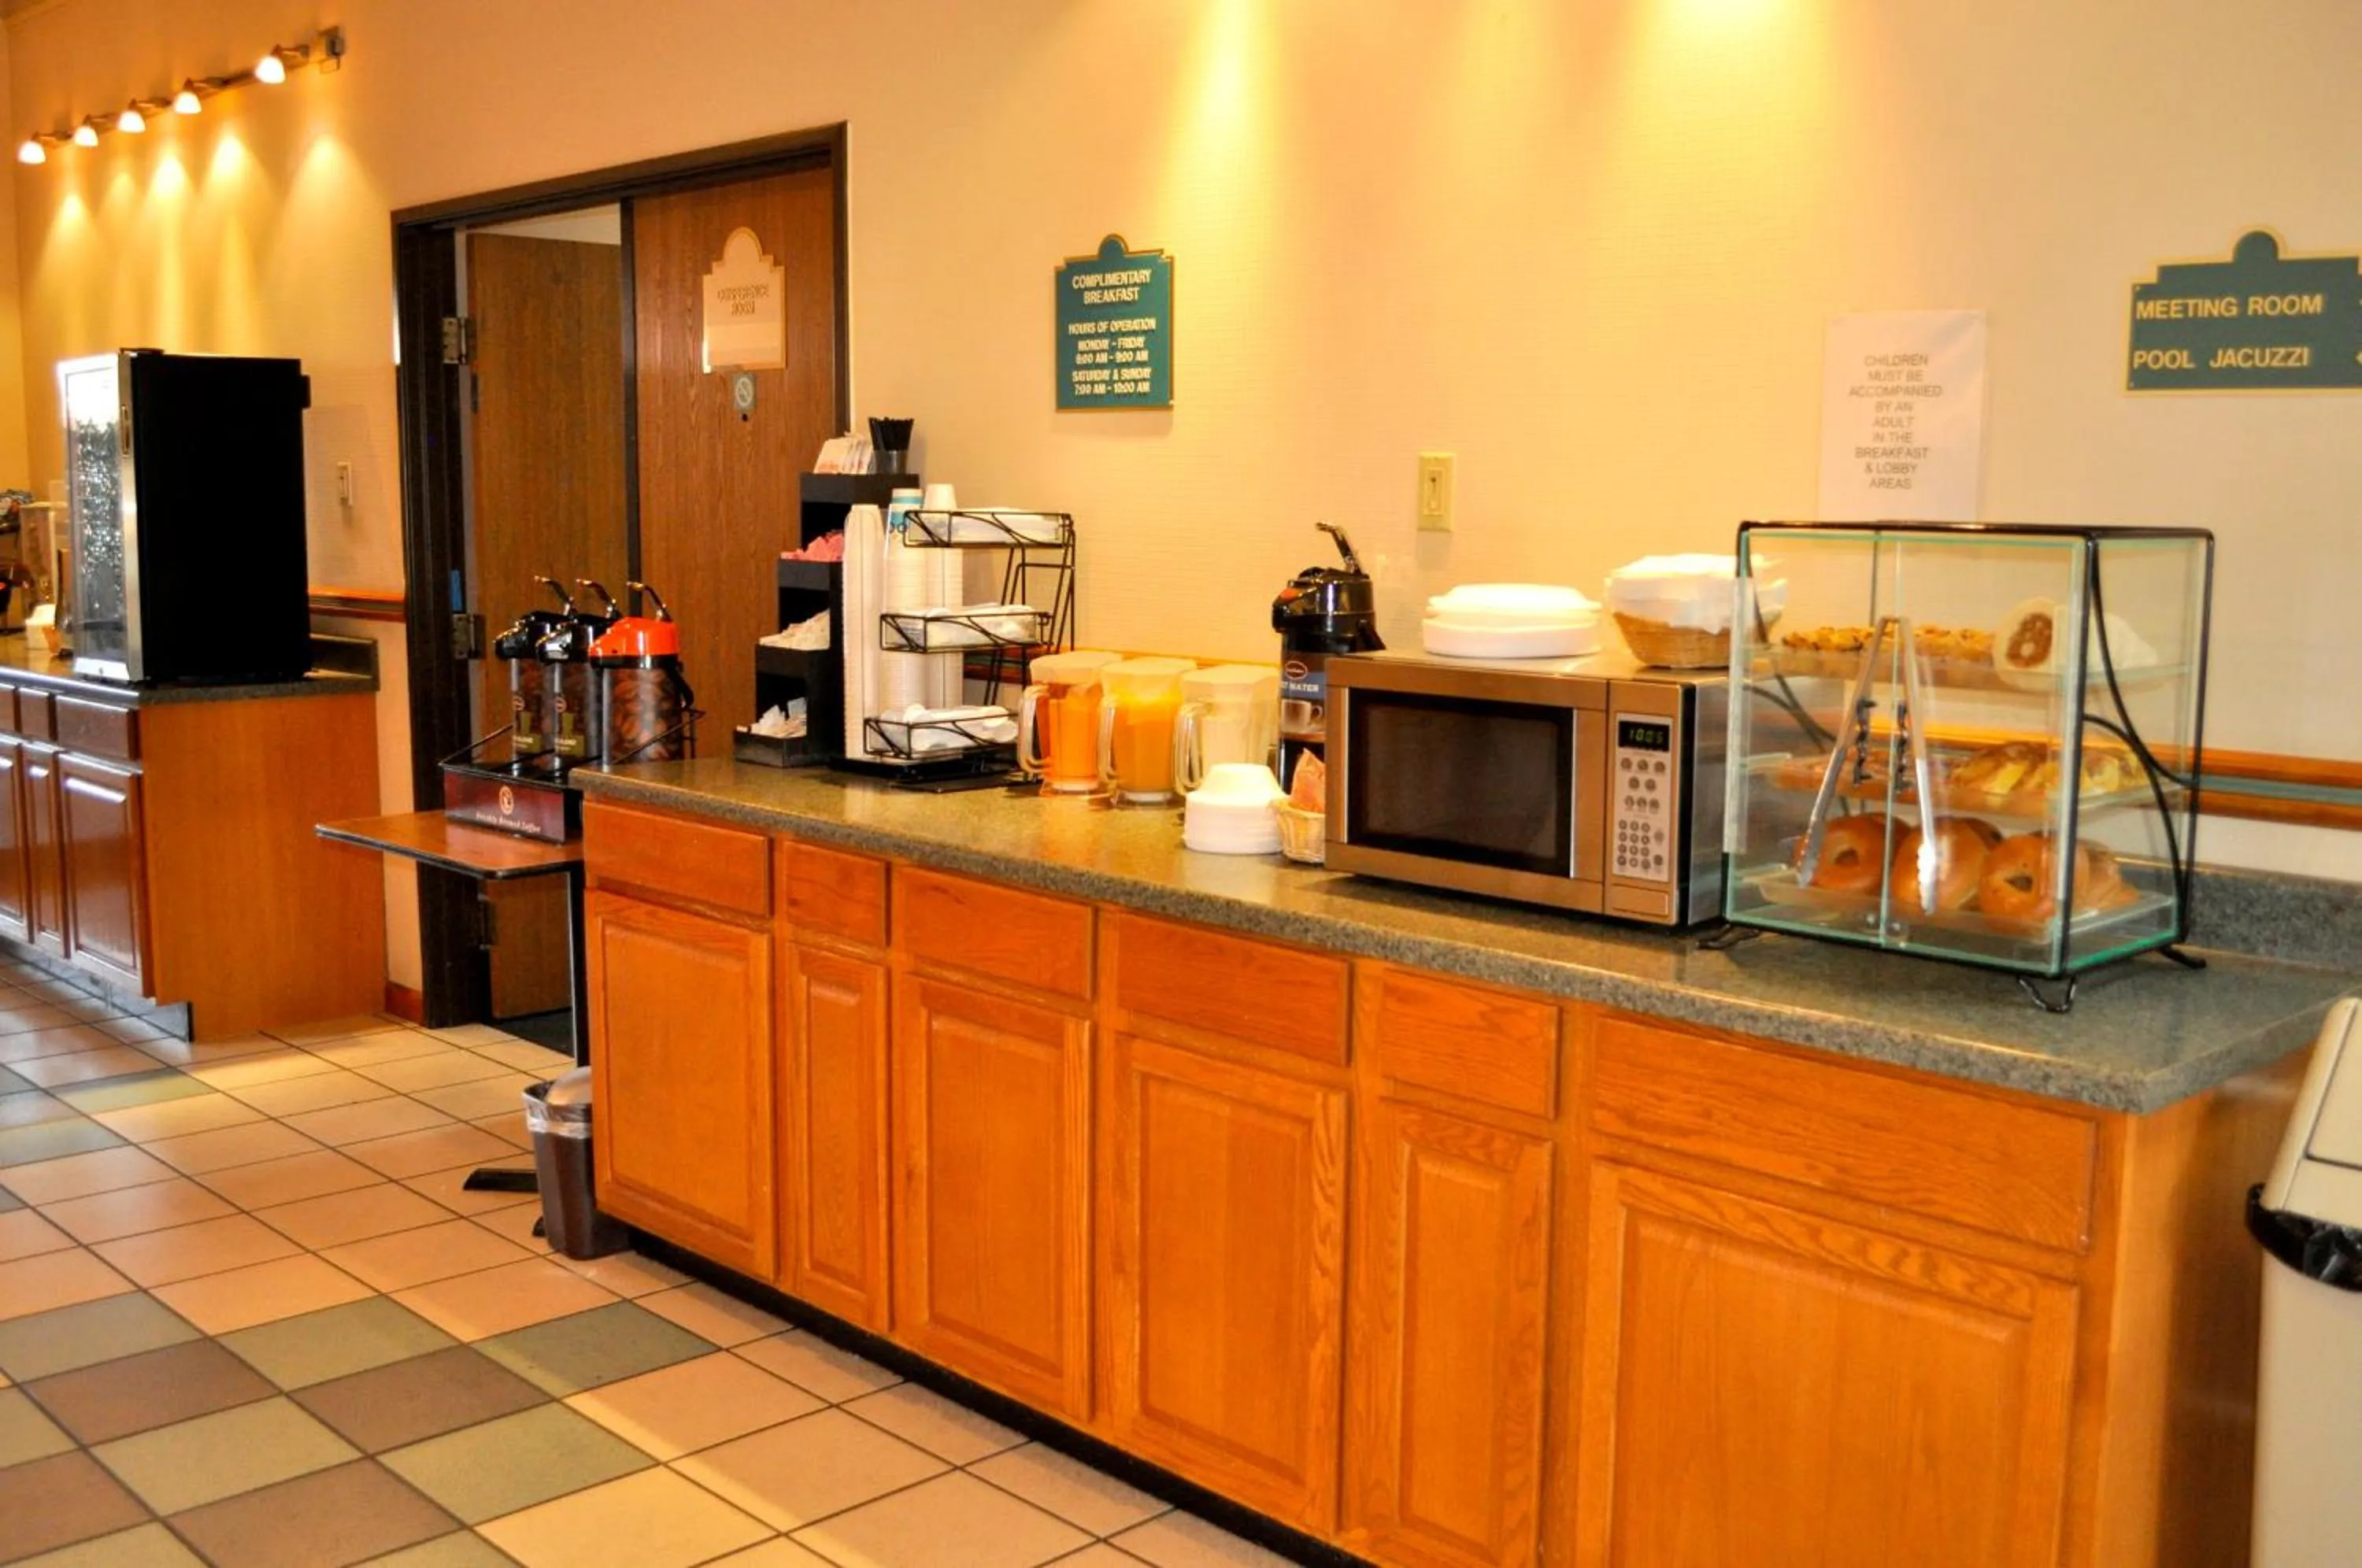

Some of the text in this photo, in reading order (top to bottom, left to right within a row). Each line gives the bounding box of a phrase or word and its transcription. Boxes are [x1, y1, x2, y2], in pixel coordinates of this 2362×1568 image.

[1072, 269, 1151, 289] COMPLIMENTARY
[1083, 287, 1139, 305] BREAKFAST
[2136, 294, 2323, 319] MEETING ROOM
[1068, 317, 1157, 335] HOURS OF OPERATION
[1078, 339, 1109, 351] MONDAY
[1118, 336, 1146, 349] FRIDAY
[1094, 351, 1108, 364] AM
[1135, 349, 1149, 362] AM
[1864, 354, 1928, 368] CHILDREN
[2133, 346, 2310, 369] POOL JACUZZI
[1072, 370, 1111, 382] SATURDAY
[1120, 367, 1152, 379] SUNDAY
[1868, 369, 1924, 383] MUST BE
[1093, 382, 1106, 394] AM
[1136, 380, 1150, 393] AM
[1849, 385, 1943, 398] ACCOMPANIED
[1875, 400, 1913, 413] BY AN
[1872, 416, 1915, 428] ADULT
[1872, 431, 1913, 444] IN THE
[1855, 446, 1929, 460] BREAKFAST
[1875, 461, 1918, 475] LOBBY
[1868, 477, 1912, 490] AREAS
[1289, 682, 1319, 693] WATER
